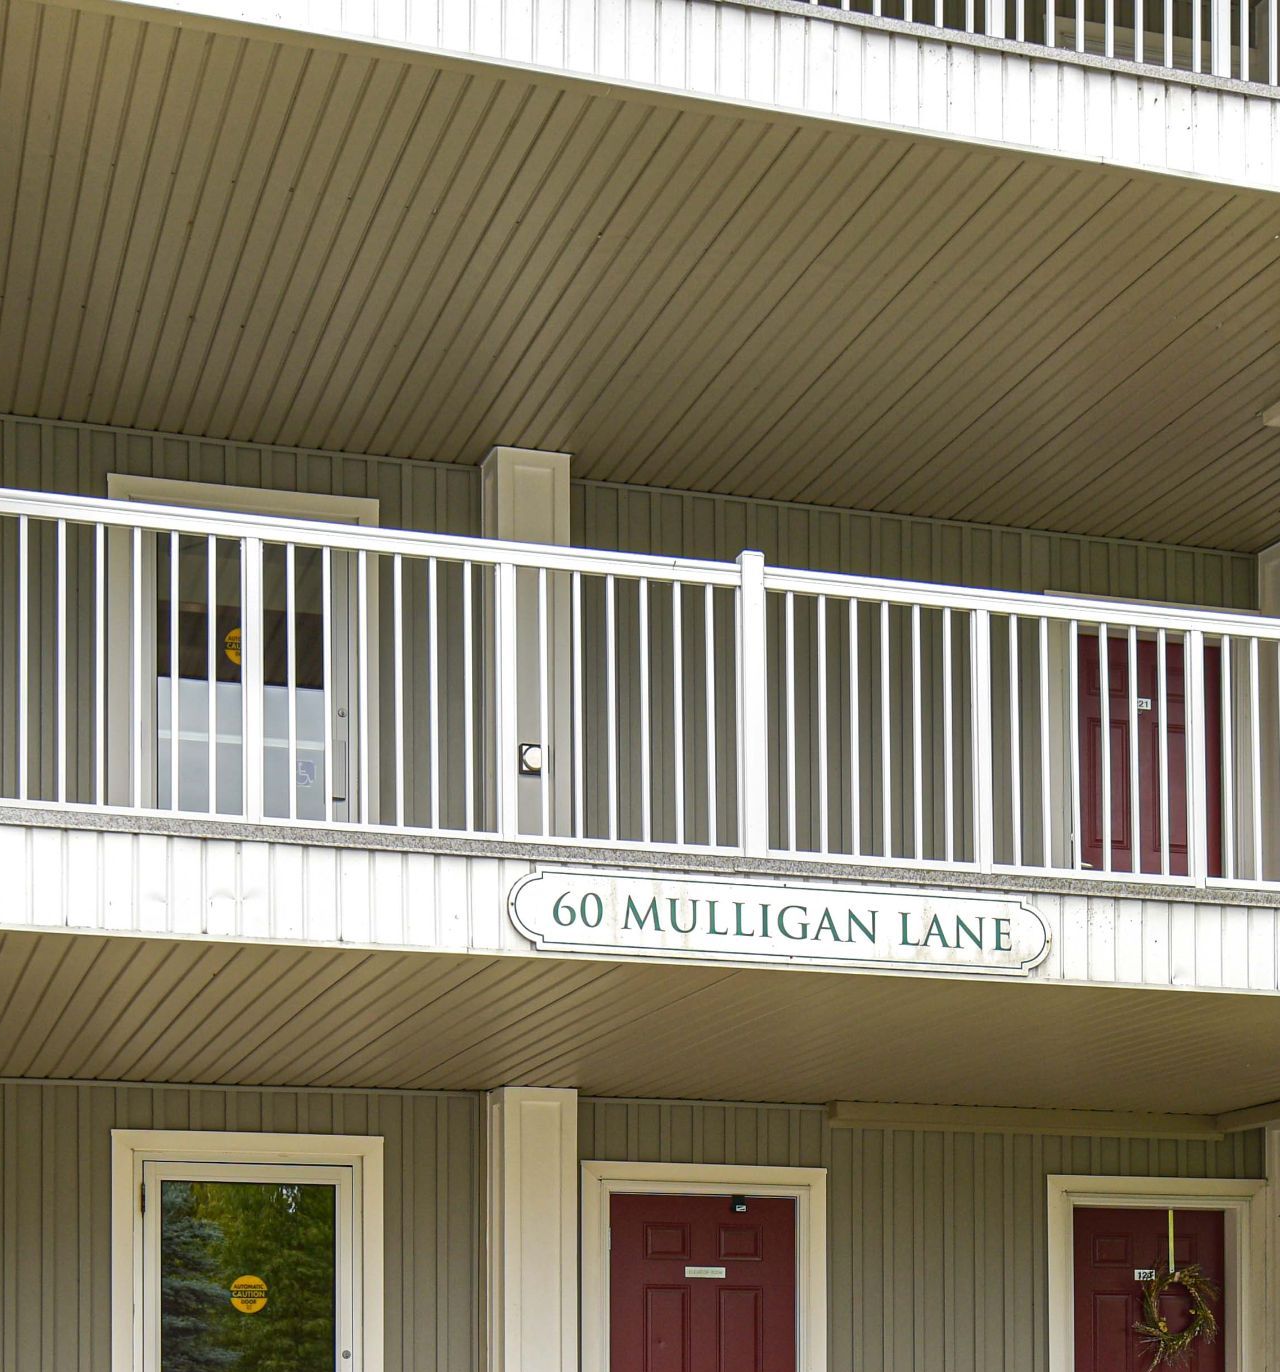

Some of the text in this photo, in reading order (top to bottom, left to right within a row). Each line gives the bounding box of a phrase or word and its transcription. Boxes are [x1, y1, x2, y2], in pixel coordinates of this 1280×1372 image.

[552, 891, 1013, 951] 60 MULLIGAN LANE
